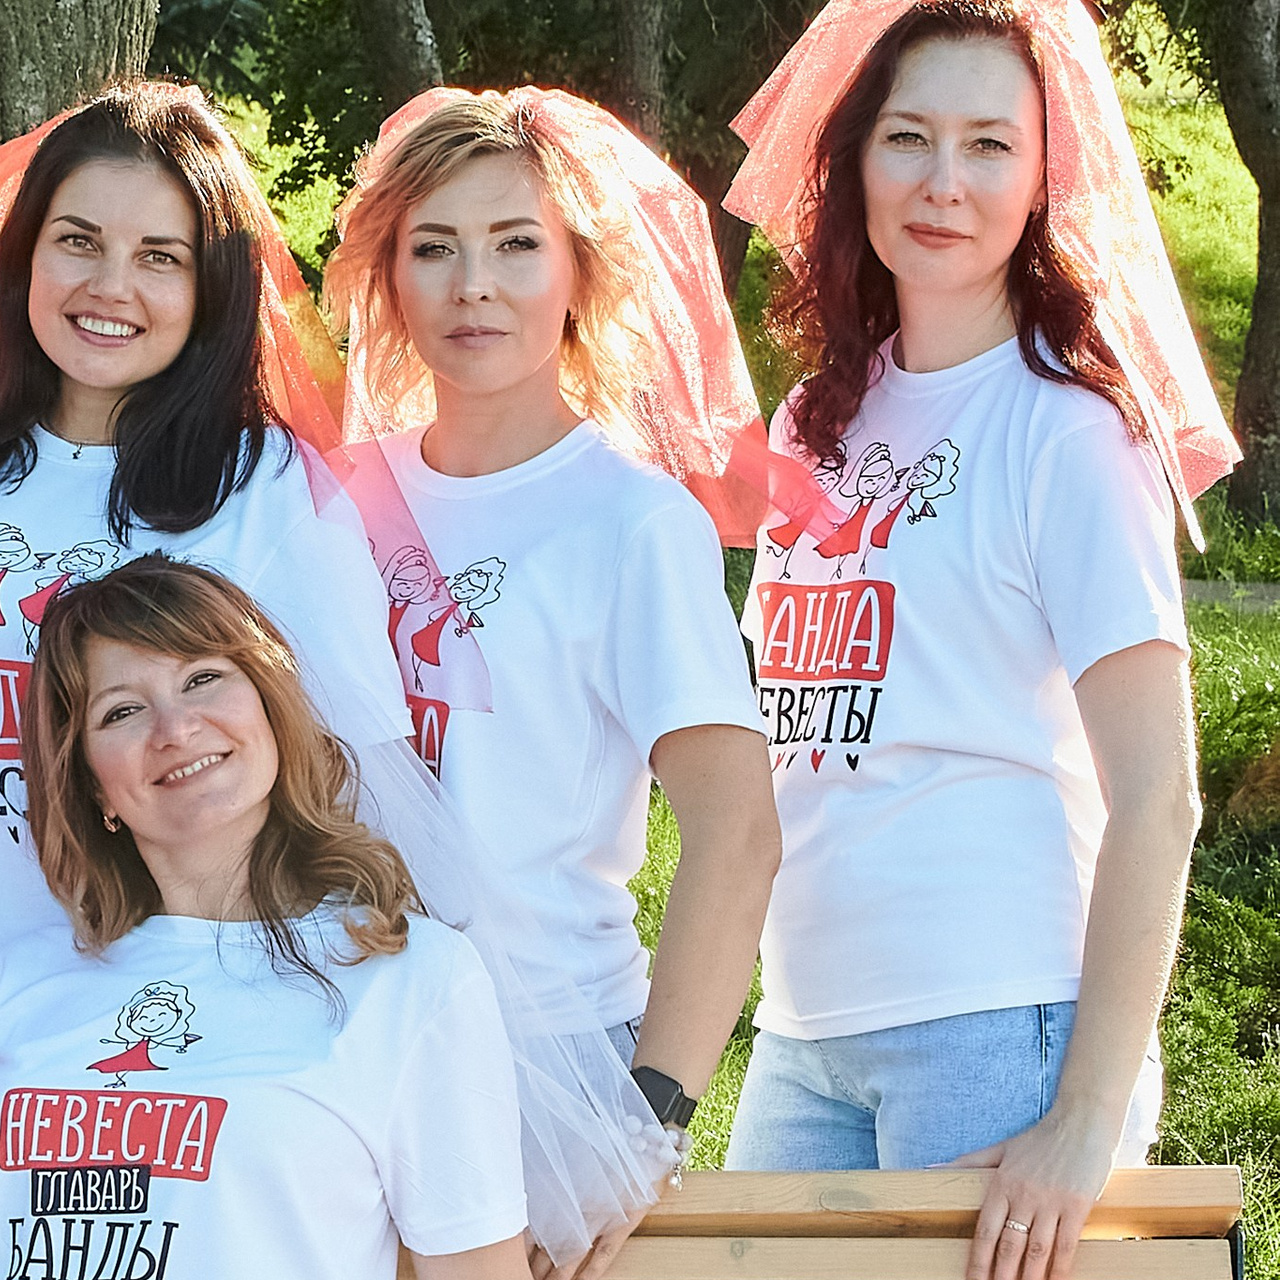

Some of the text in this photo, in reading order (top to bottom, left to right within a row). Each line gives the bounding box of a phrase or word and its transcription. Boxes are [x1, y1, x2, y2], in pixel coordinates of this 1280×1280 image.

[761, 586, 881, 675] АНДА
[758, 685, 882, 746] ЕВЕСТЫ
[6, 1093, 210, 1172] НЕВЕСТА
[35, 1169, 145, 1213] ГЛАВАРЬ
